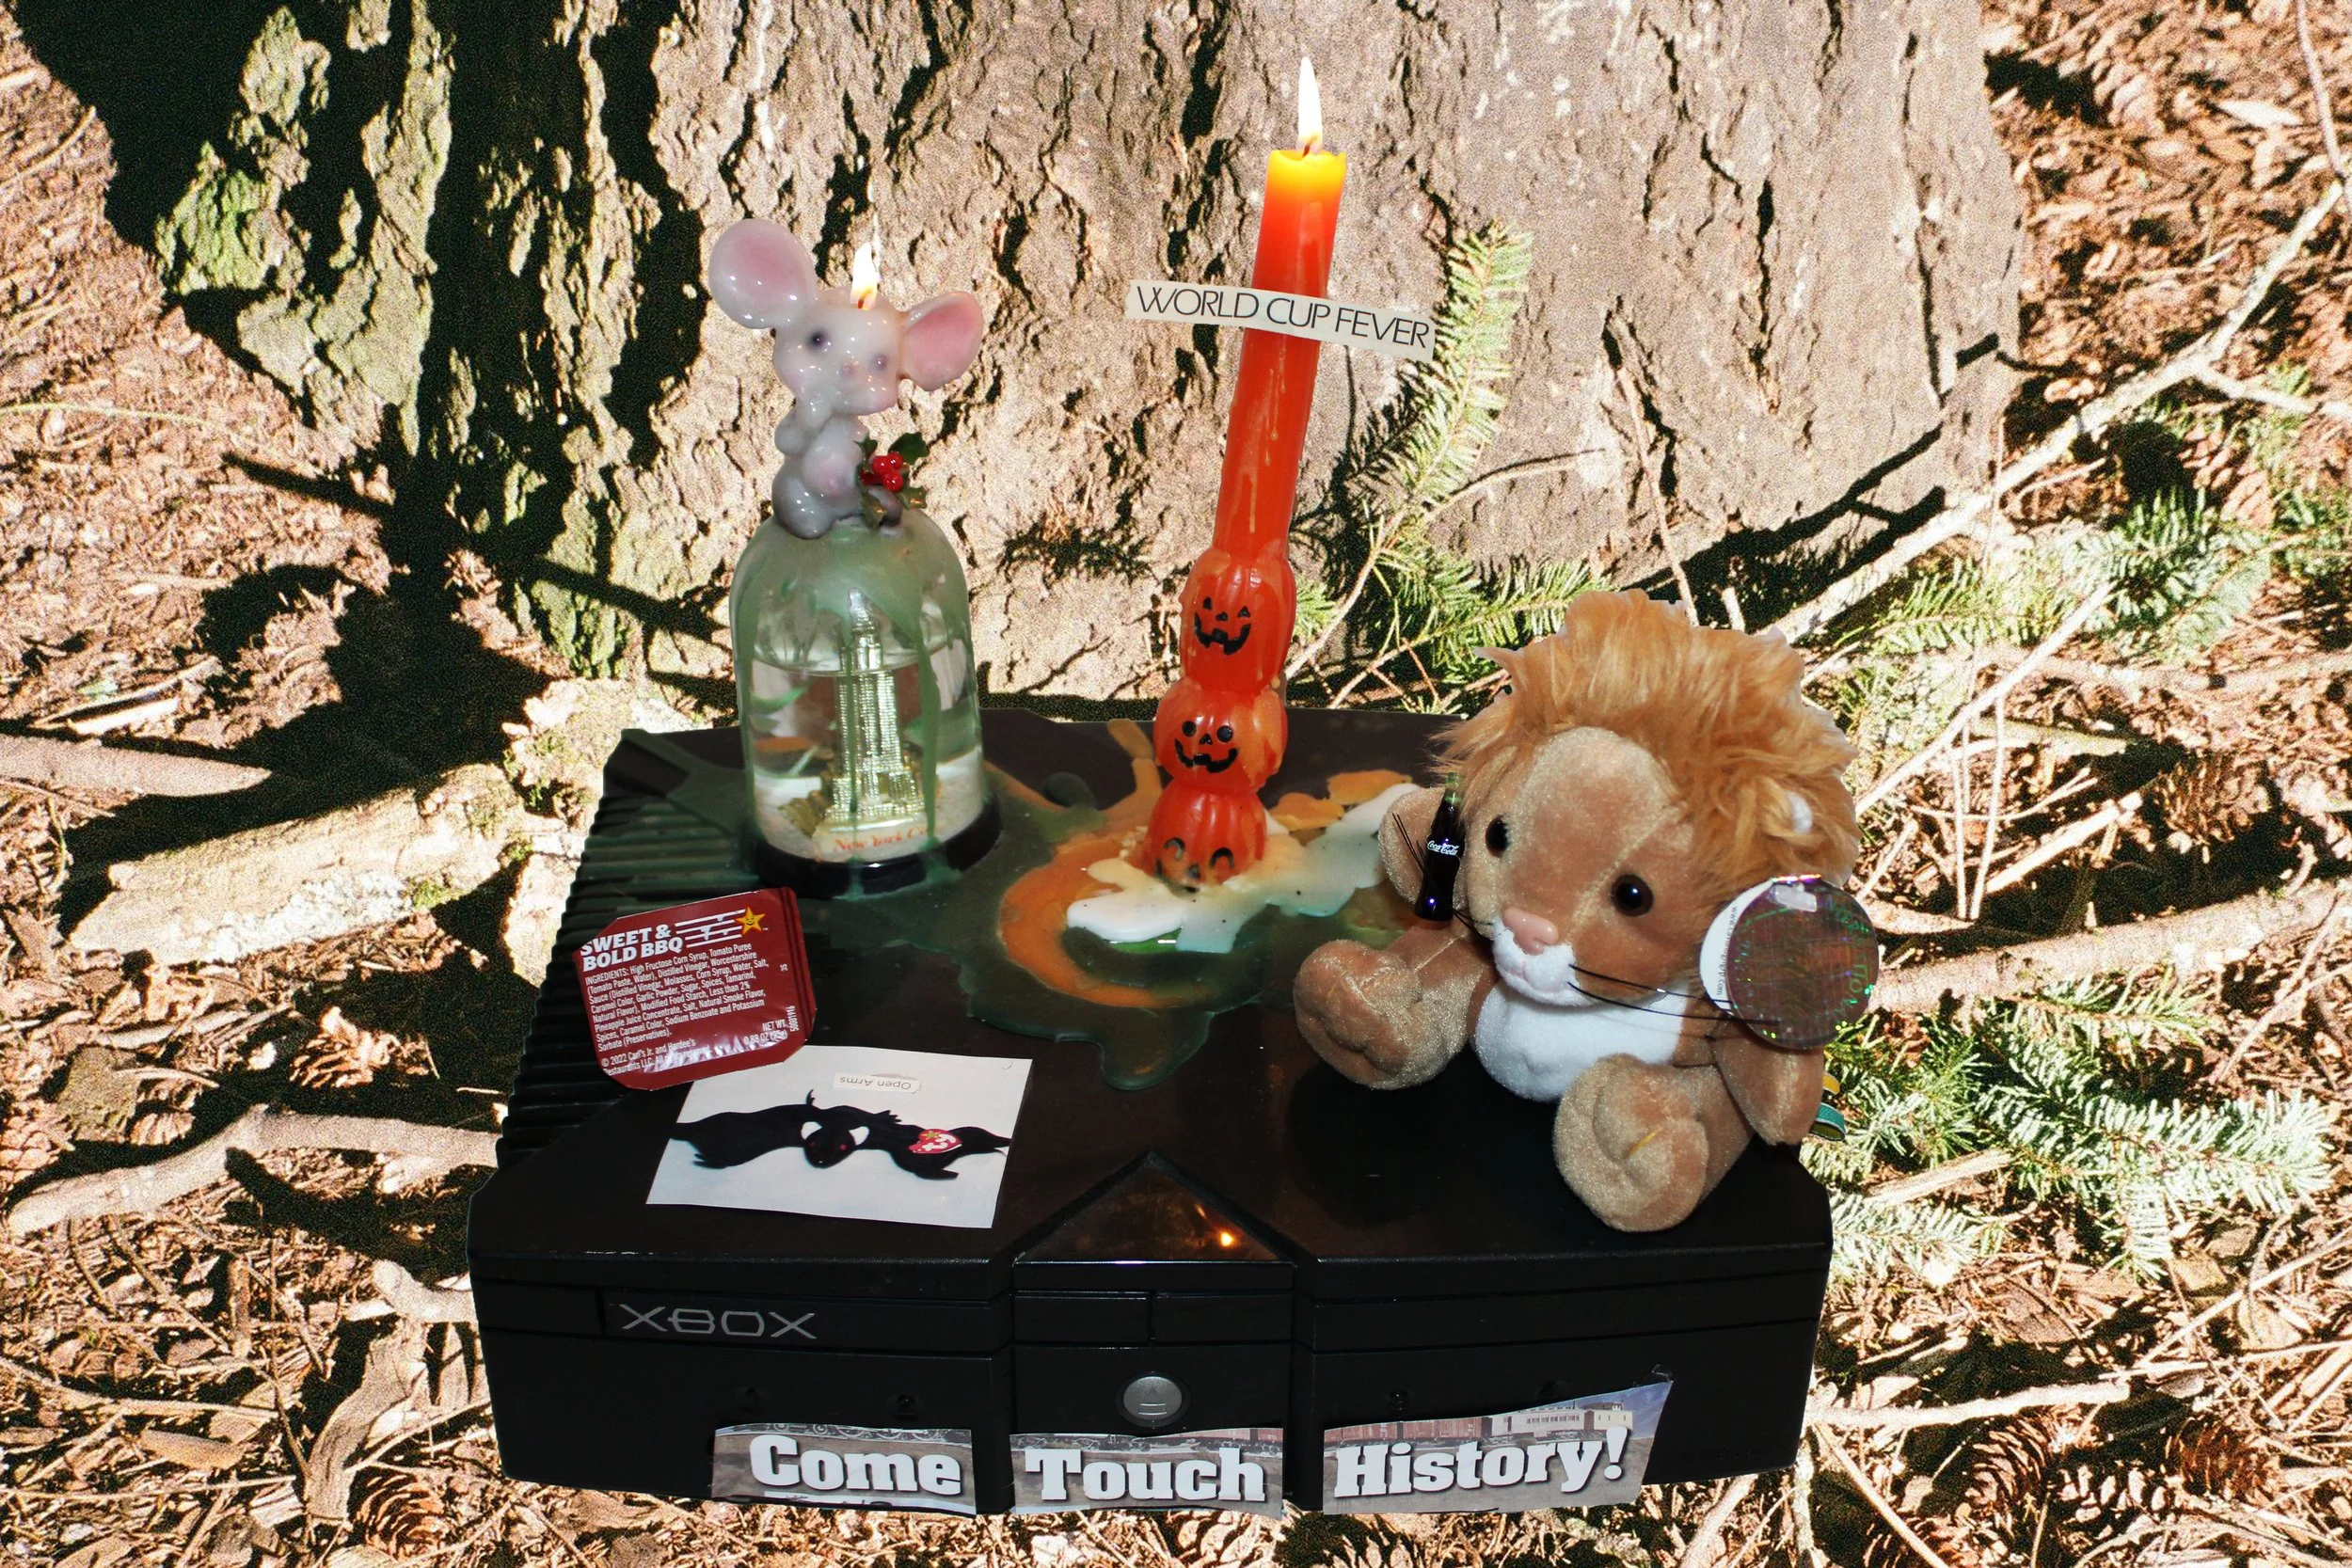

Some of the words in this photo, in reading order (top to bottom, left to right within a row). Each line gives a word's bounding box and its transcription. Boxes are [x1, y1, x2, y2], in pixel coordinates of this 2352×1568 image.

[1136, 285, 1260, 319] WORLD
[1266, 297, 1331, 329] CUP
[1334, 307, 1430, 349] FEVER
[580, 927, 653, 956] SWEET
[656, 924, 671, 939] &
[583, 947, 638, 972] BOLD
[641, 937, 683, 958] BBQ
[585, 968, 628, 985] INGREDIENTS:
[630, 964, 644, 976] High
[645, 958, 673, 971] Fructose
[674, 955, 688, 965] Corn
[709, 946, 733, 958] Tomato
[734, 942, 752, 952] Puree
[587, 982, 612, 995] (Tomato
[659, 966, 683, 977] Distilled
[711, 951, 757, 966] Worcestershire
[590, 993, 609, 1005] Sauce
[610, 986, 637, 1000] (Distilled
[696, 970, 711, 979] Corn
[592, 1001, 616, 1014] Caramel
[636, 991, 655, 1003] Garlic
[594, 1010, 615, 1023] Natural
[641, 999, 668, 1010] Modified
[670, 995, 685, 1005] Food
[709, 987, 723, 996] Less
[724, 984, 739, 993] than
[595, 1019, 625, 1034] Pineapple
[627, 1014, 642, 1024] Juice
[699, 997, 722, 1008] Natural
[723, 992, 744, 1003] Smoke
[620, 1023, 645, 1036] Caramel
[665, 1014, 689, 1025] Sodium
[690, 1007, 718, 1020] Benzoate
[720, 1005, 732, 1013] and
[733, 999, 764, 1011] Potassium
[762, 1022, 775, 1031] NET
[598, 1038, 623, 1052] Sorbate
[760, 1033, 770, 1041] OZ
[611, 1054, 628, 1065] 2022
[655, 1045, 667, 1054] and
[839, 1076, 874, 1086] Arms
[876, 1081, 913, 1091] Open
[619, 1304, 818, 1339] XBOX
[750, 1434, 962, 1495] Come
[1025, 1446, 1266, 1503] Touch
[1334, 1426, 1631, 1499] History!
